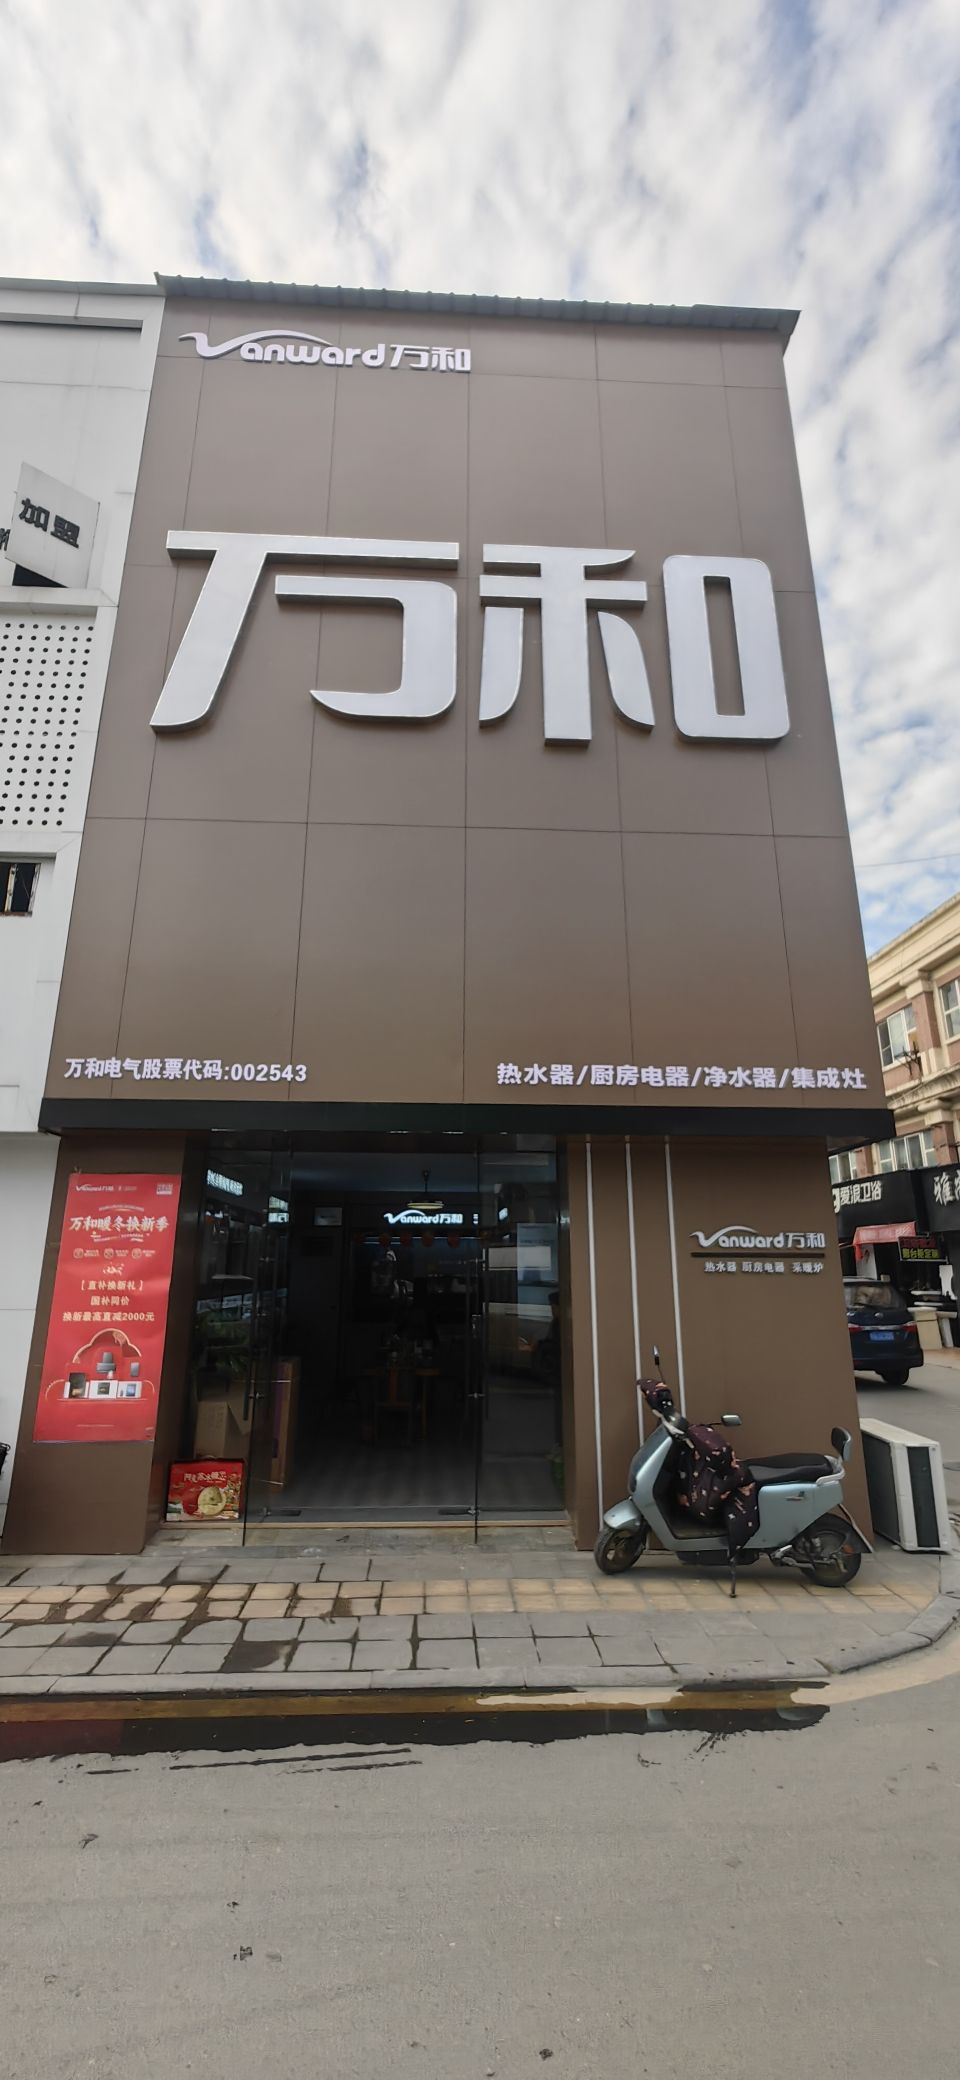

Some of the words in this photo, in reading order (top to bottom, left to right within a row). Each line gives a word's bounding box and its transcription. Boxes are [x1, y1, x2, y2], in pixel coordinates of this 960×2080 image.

[179, 329, 385, 367] Vanward
[389, 343, 472, 373] 万和
[19, 498, 80, 549] 加盟
[149, 529, 791, 747] 万和
[64, 1057, 307, 1082] 万和电气股票代码:002543
[496, 1062, 868, 1090] 热水器/厨房电器/净水器/集成灶
[690, 1225, 784, 1248] Vanward
[785, 1232, 826, 1248] 万和
[704, 1261, 737, 1273] 热水器
[742, 1261, 785, 1273] 厨房电器
